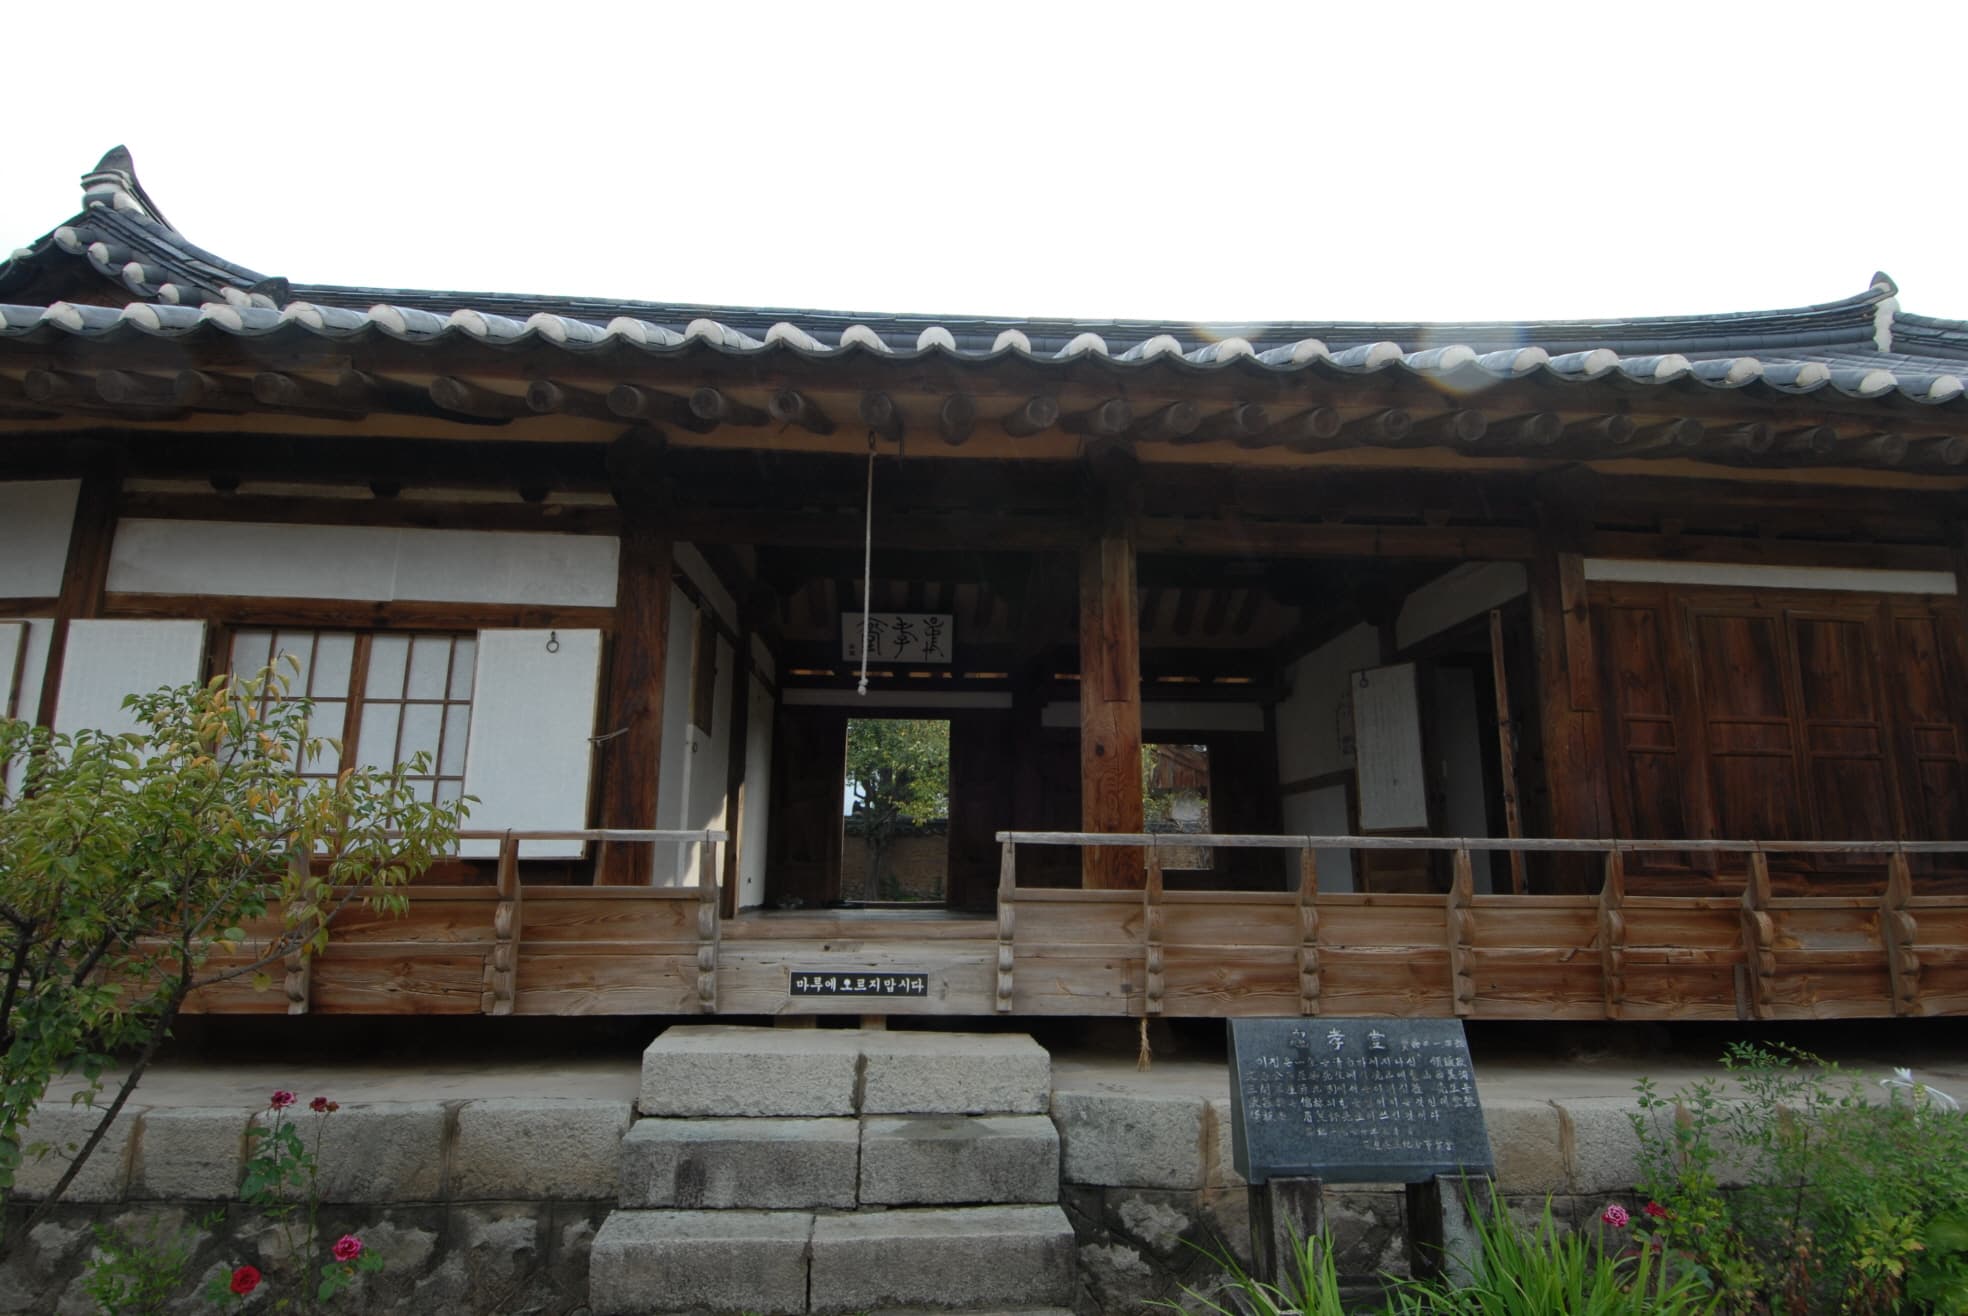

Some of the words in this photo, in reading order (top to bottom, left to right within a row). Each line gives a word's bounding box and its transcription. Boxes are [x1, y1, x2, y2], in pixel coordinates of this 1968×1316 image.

[796, 976, 837, 992] 마루에
[839, 976, 881, 993] 오르지
[883, 977, 925, 993] 맙시다
